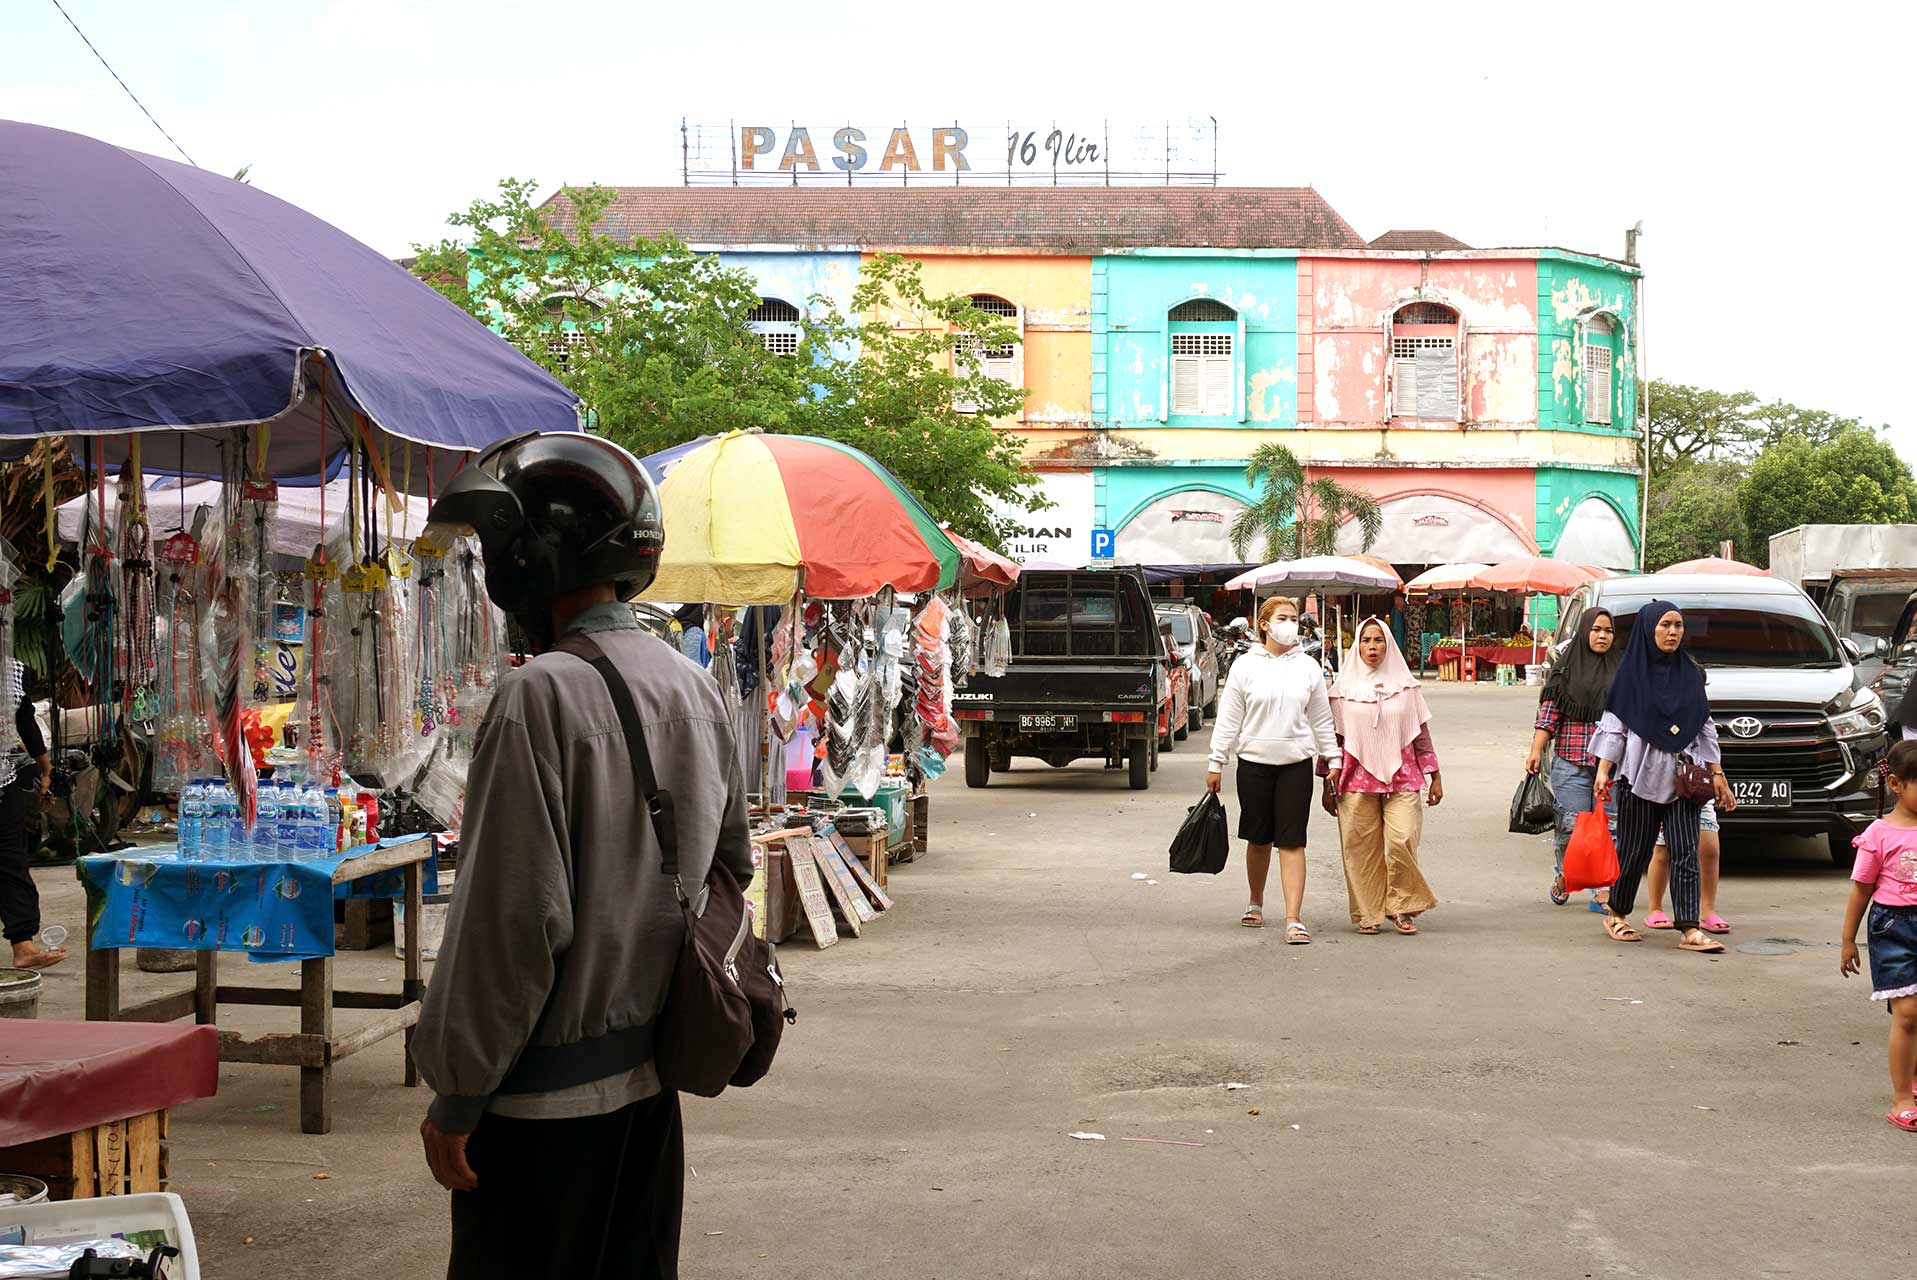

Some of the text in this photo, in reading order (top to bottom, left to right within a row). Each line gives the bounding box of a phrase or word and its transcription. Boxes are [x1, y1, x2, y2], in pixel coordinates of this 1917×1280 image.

[741, 126, 972, 171] PASAR
[1008, 131, 1037, 166] 16
[1015, 543, 1049, 554] ILIR
[1095, 533, 1109, 554] P
[1021, 716, 1033, 727] BG
[1034, 716, 1056, 727] 9965
[1733, 782, 1763, 798] 1242
